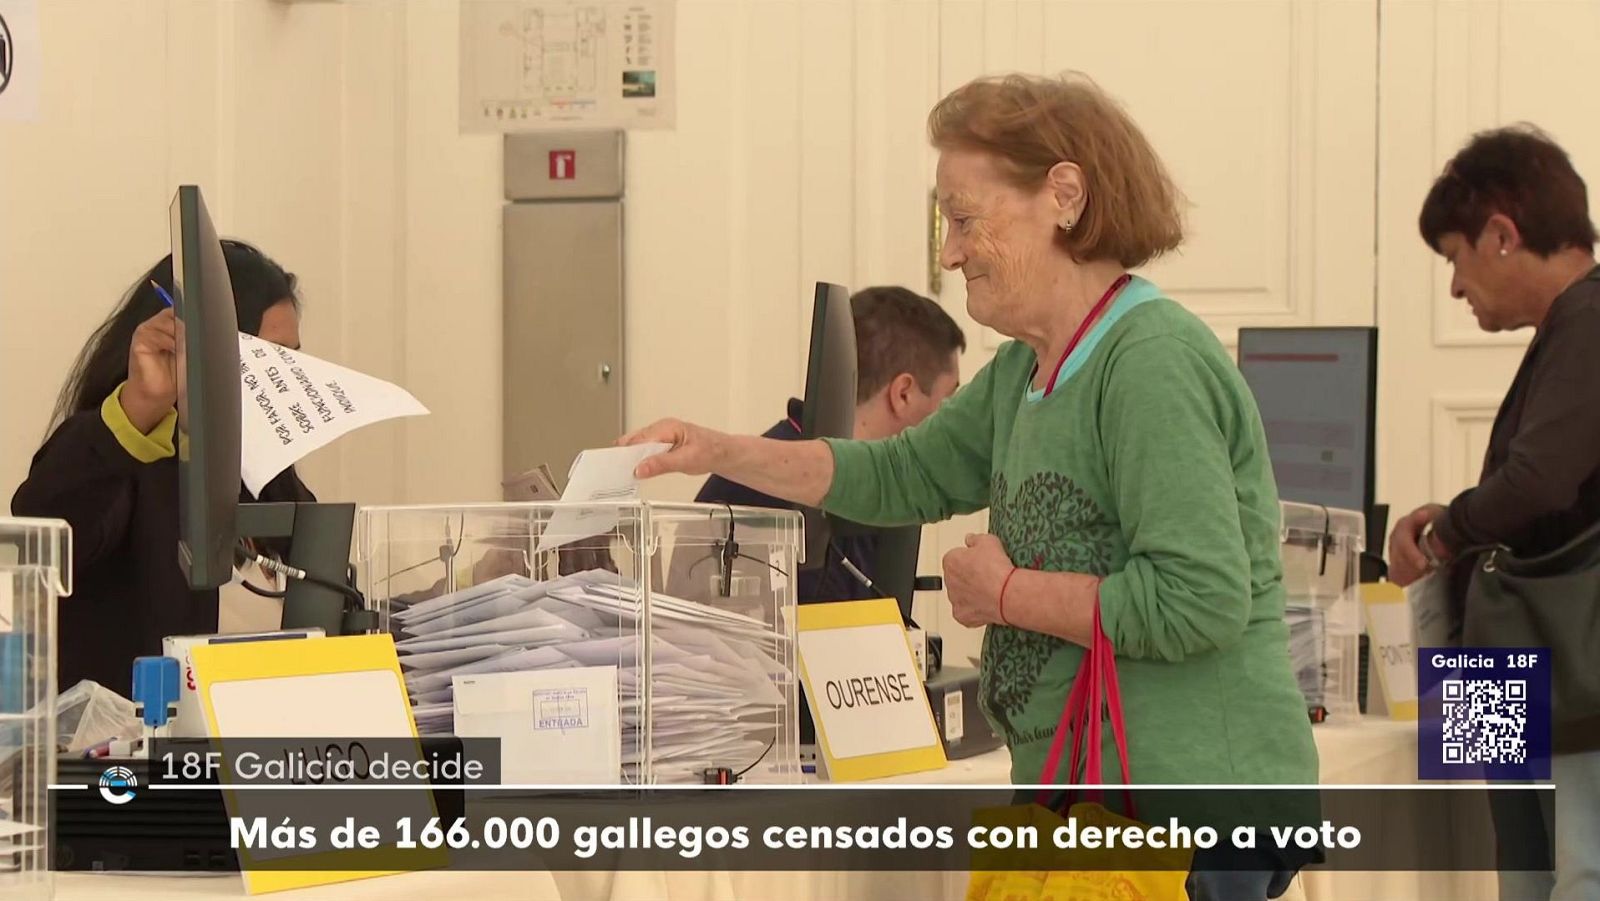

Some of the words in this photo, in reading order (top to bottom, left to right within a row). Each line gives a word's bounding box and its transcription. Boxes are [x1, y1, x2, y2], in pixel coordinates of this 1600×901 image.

[244, 374, 260, 391] NO
[264, 365, 290, 394] ANTES
[288, 402, 315, 434] SOBRE
[275, 423, 294, 445] POR
[825, 673, 914, 710] OURENSE
[538, 718, 584, 728] ENTRADA
